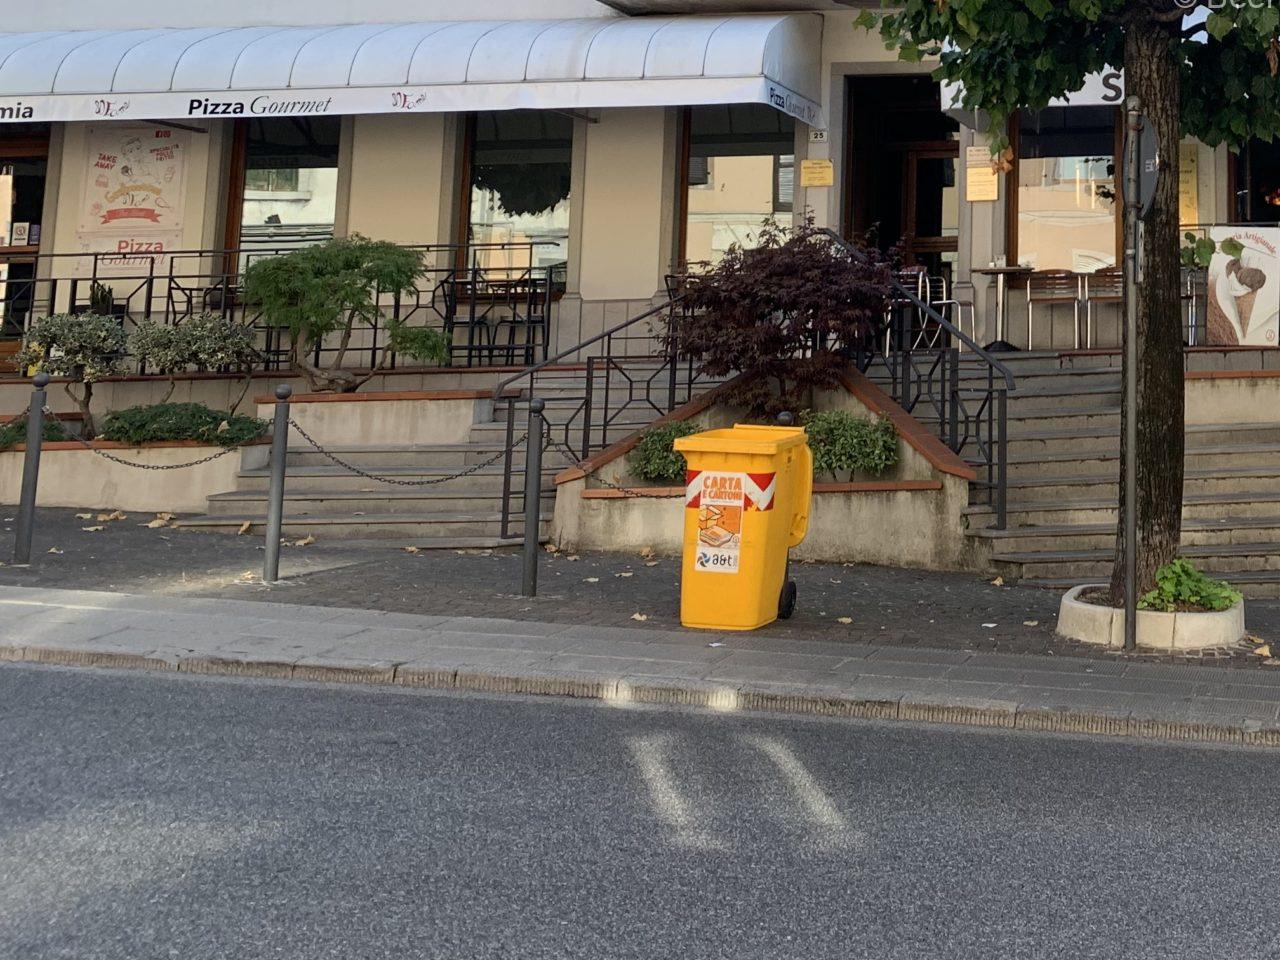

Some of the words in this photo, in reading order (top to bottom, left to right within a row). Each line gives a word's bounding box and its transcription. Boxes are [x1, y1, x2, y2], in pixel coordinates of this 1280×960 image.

[188, 98, 245, 115] Pizza
[250, 96, 332, 115] Gourmet
[98, 152, 118, 163] TAKE
[94, 161, 115, 170] AWAY
[117, 239, 164, 254] Pizza
[100, 250, 167, 266] Gourmet
[703, 475, 742, 490] CARTA
[702, 490, 708, 499] E
[712, 553, 733, 567] a&t
